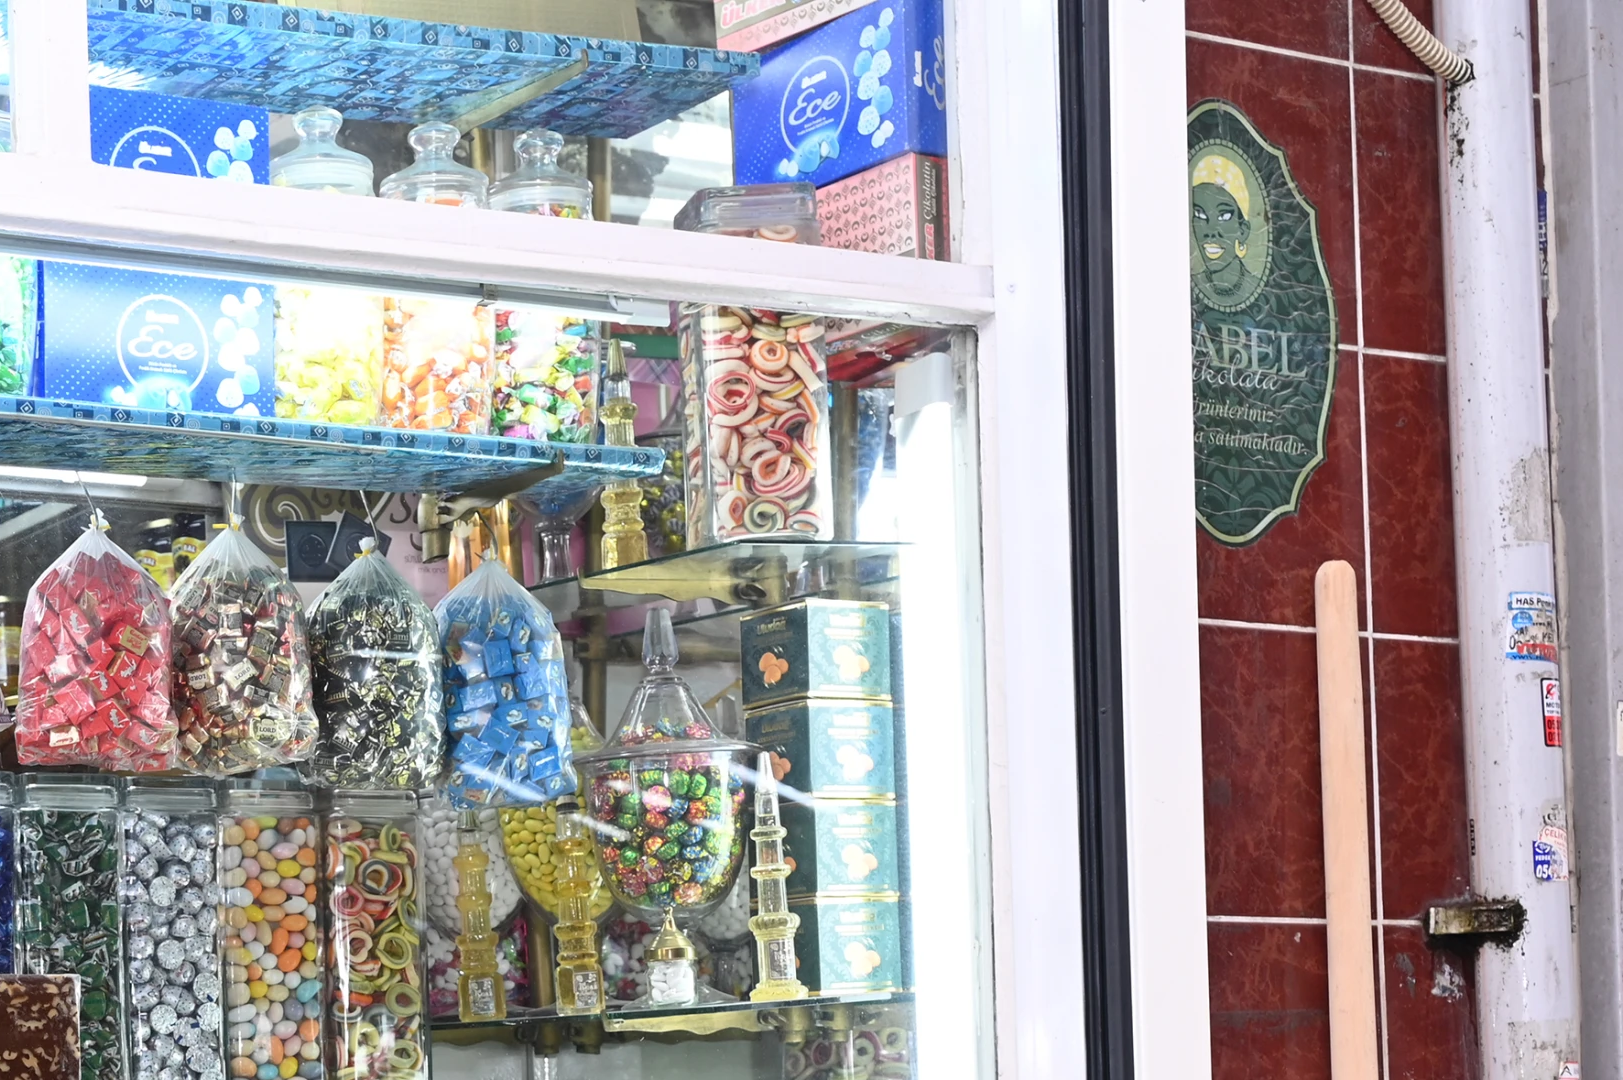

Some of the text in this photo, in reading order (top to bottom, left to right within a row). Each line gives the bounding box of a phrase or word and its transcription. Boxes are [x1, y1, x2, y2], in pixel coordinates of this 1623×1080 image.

[788, 87, 841, 125] Ece
[925, 224, 935, 260] KER
[127, 325, 198, 361] Ece
[1192, 321, 1308, 378] ABEL
[1192, 355, 1278, 391] ikolata
[1192, 392, 1274, 425] rünlerimiz
[259, 726, 276, 734] LORD
